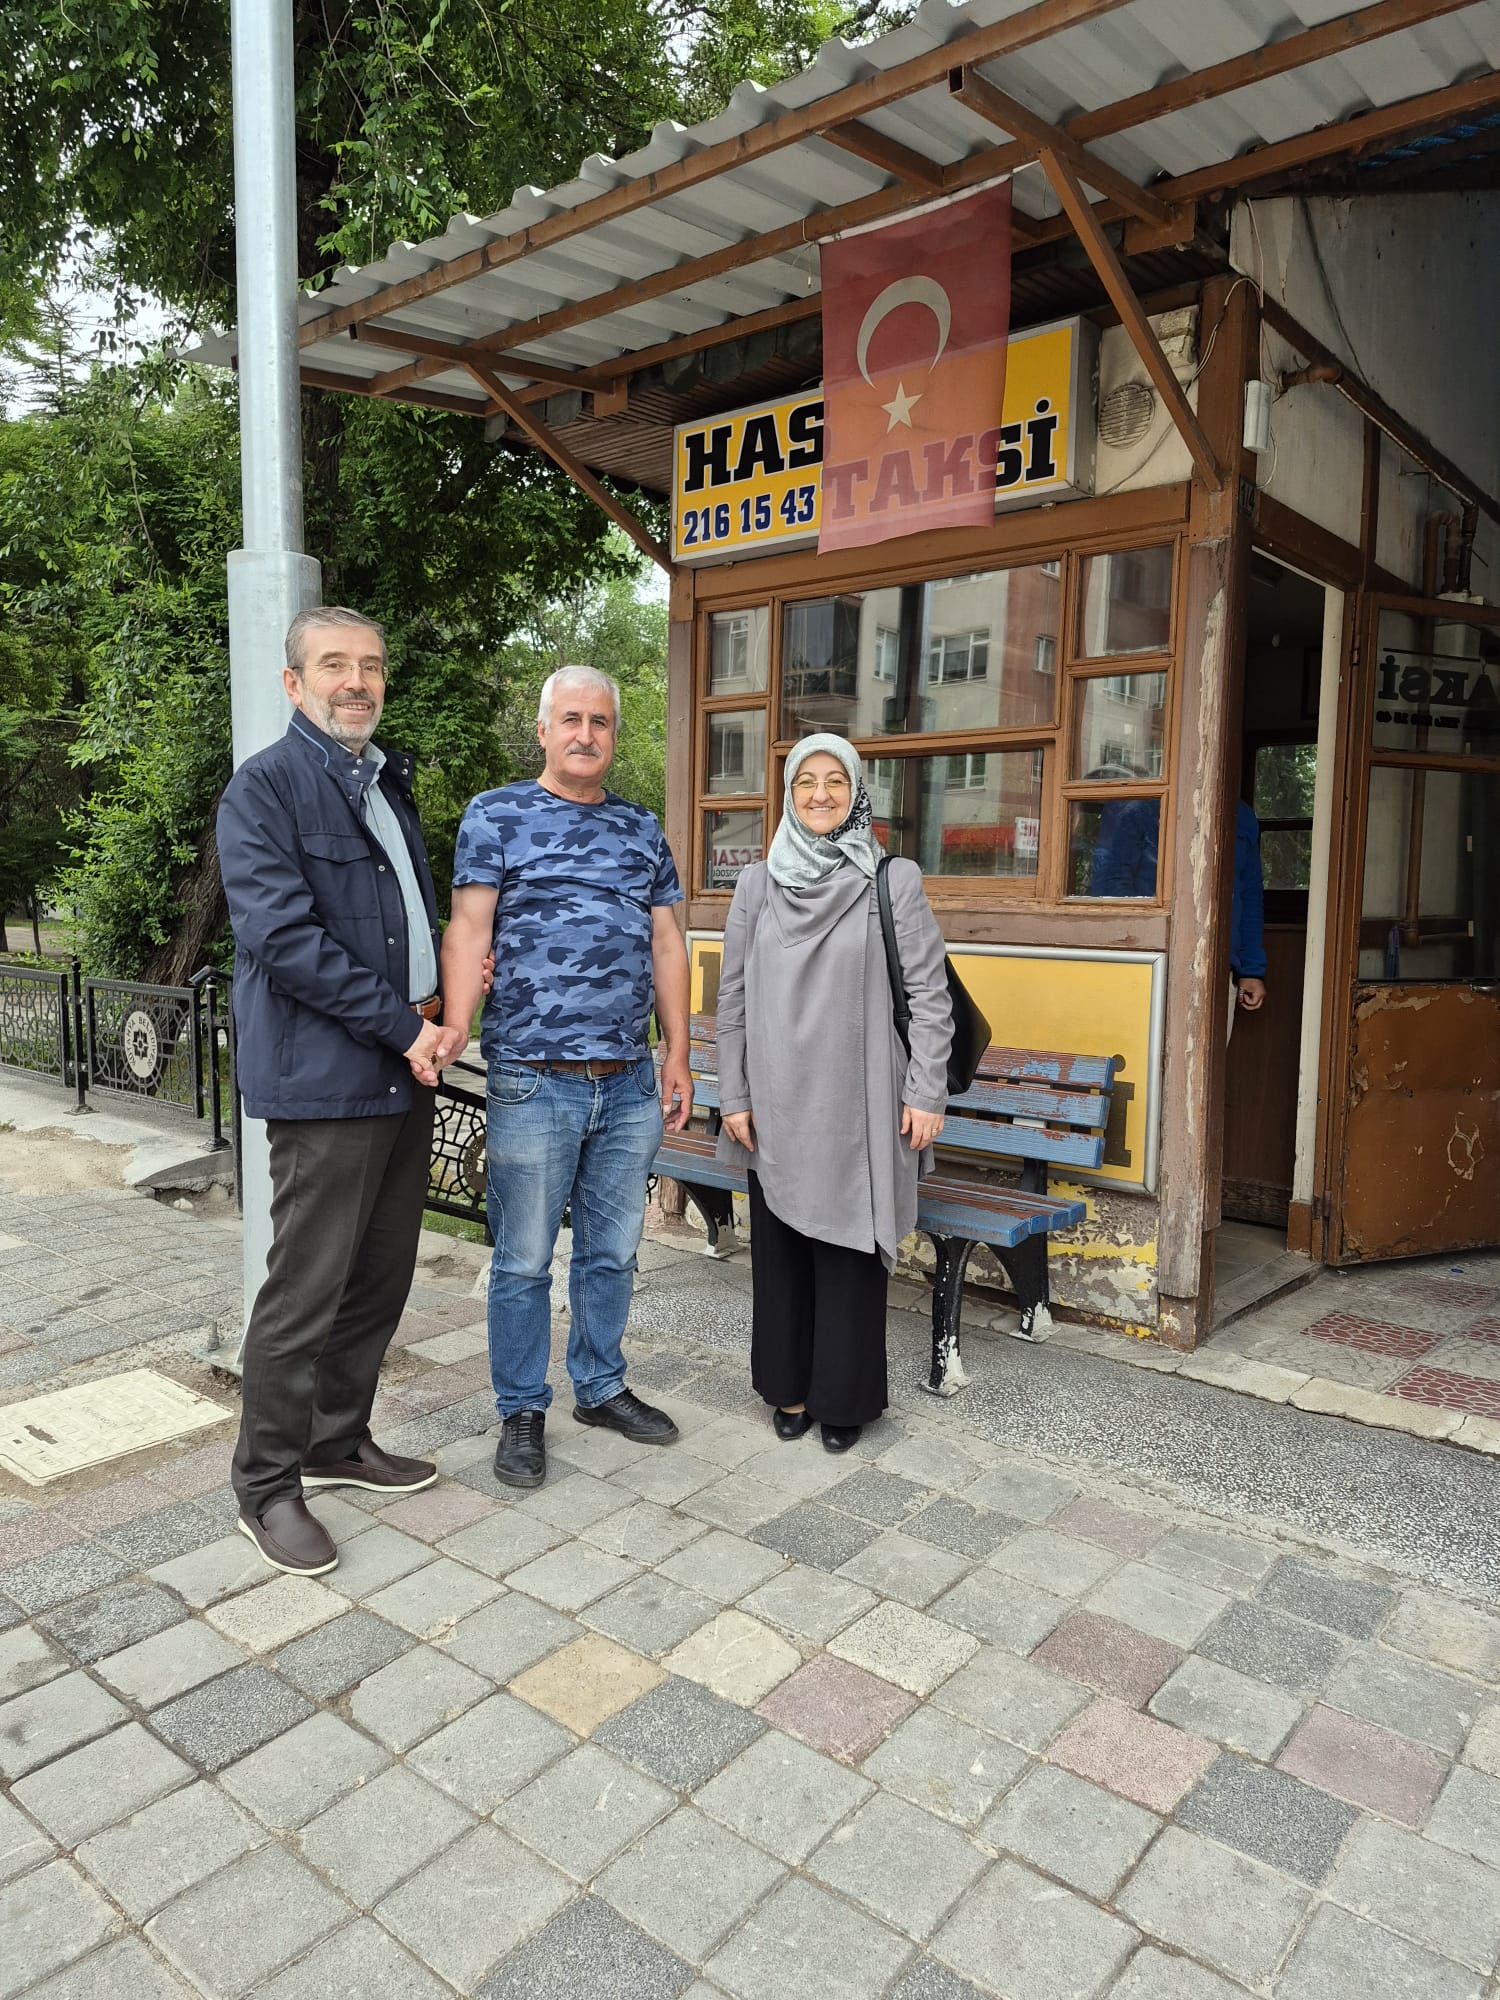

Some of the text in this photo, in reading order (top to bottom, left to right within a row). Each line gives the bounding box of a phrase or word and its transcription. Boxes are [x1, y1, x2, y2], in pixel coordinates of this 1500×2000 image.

[683, 400, 832, 494] HAS
[823, 396, 1061, 522] TAKSİ
[682, 484, 816, 547] 216 15 43
